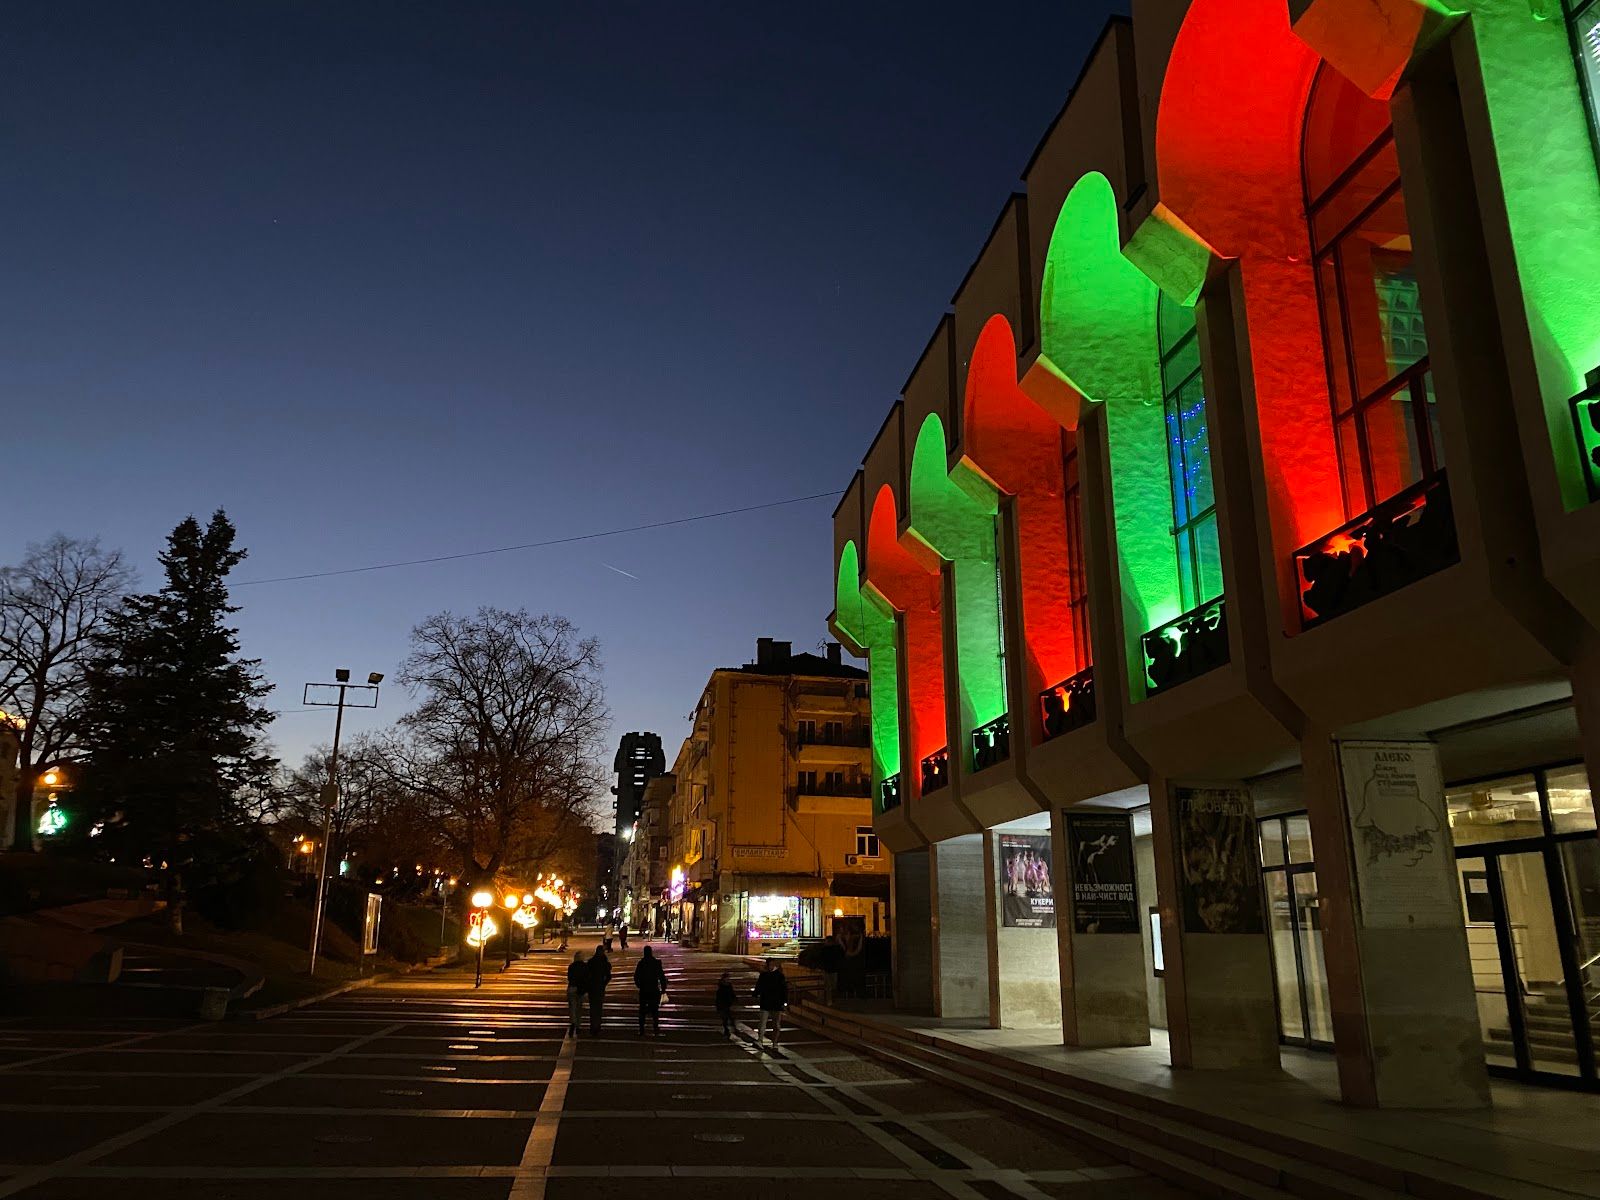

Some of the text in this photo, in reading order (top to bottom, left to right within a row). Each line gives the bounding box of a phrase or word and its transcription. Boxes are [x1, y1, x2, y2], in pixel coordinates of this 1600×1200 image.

[1074, 883, 1133, 892] НЕВЪЗМОЖНОСТ
[1030, 898, 1054, 906] КУКЕРИ
[1075, 893, 1081, 901] В
[1119, 893, 1134, 902] ВИД
